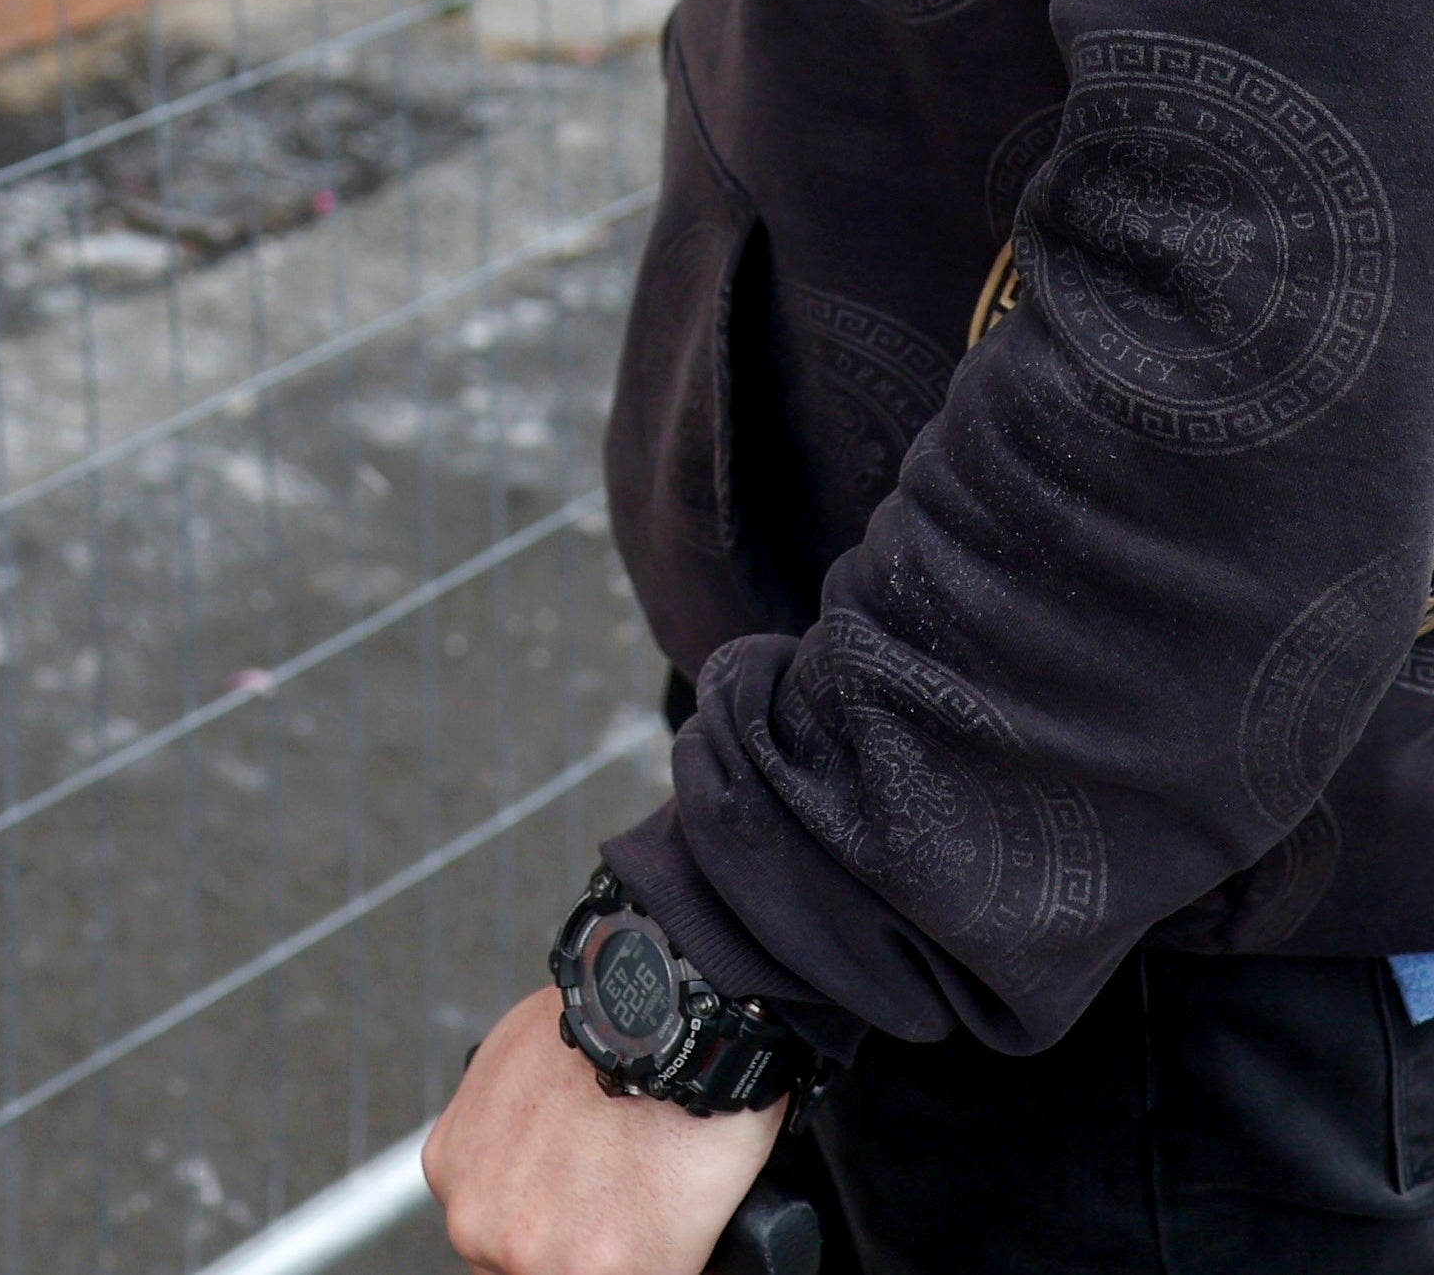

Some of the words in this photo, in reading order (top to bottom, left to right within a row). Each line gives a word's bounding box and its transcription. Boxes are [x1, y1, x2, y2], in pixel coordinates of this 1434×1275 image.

[1154, 99, 1176, 122] &
[1195, 110, 1317, 232] DEMAND
[1098, 331, 1176, 383] CITY
[604, 965, 629, 999] 43
[611, 961, 659, 1029] 9:22
[656, 1012, 674, 1039] CASIO
[657, 1017, 700, 1082] G-SHOCK
